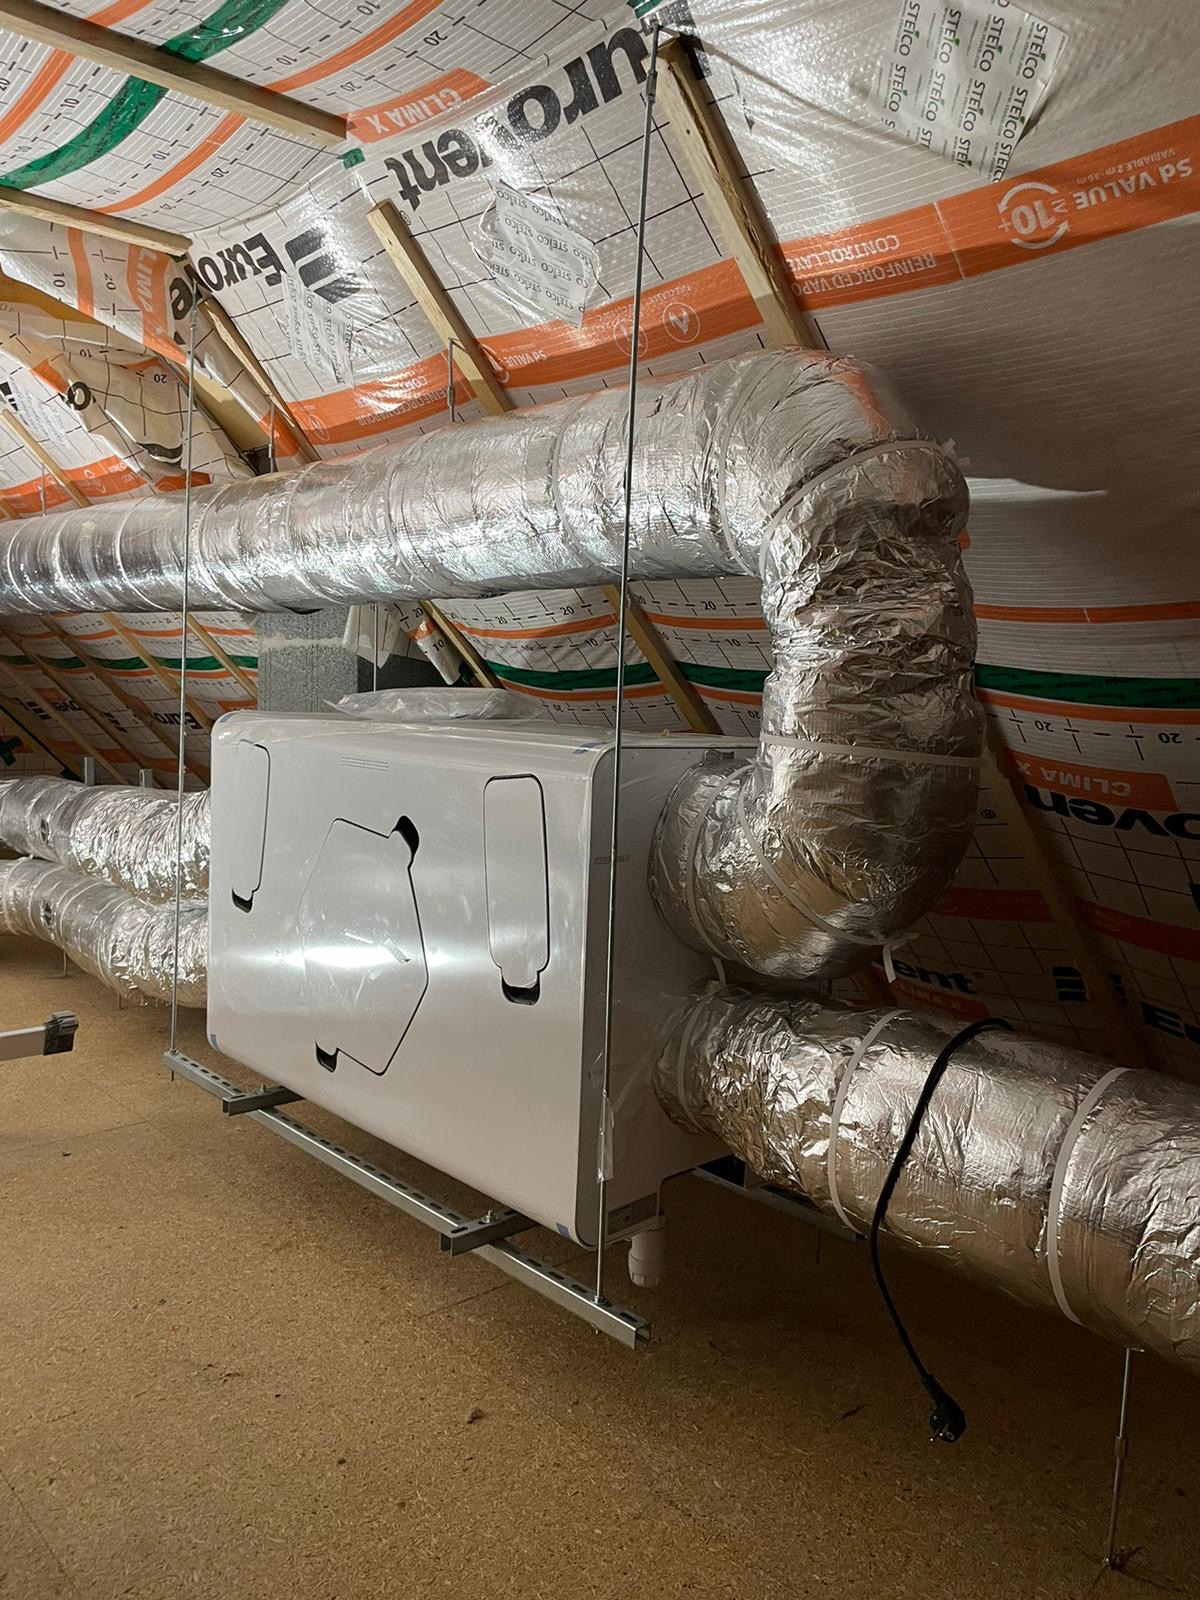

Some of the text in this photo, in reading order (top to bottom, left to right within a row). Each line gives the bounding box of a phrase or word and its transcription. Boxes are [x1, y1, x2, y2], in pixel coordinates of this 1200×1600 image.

[424, 30, 449, 47] 20
[899, 1, 921, 57] STEICO
[939, 8, 962, 64] STEICO
[979, 15, 1006, 73] STEICO
[1022, 23, 1049, 80] STEICO
[276, 54, 298, 66] 10
[339, 81, 363, 93] 20
[888, 63, 909, 113] STEICO
[925, 71, 947, 122] STEICO
[60, 98, 80, 109] 10
[384, 87, 462, 129] CLIMA
[962, 80, 986, 132] STEICO
[1003, 87, 1029, 139] STEICO
[152, 150, 170, 161] 10
[210, 167, 230, 178] 20
[1158, 158, 1193, 184] Sd
[496, 190, 528, 209] STEICO
[1072, 171, 1158, 210] VALUE
[504, 217, 534, 238] STEICO
[536, 233, 569, 253] STEICO
[820, 234, 901, 263] CONTROL
[509, 245, 537, 267] STEICO
[52, 270, 66, 289] 10
[541, 262, 572, 281] STEICO
[831, 252, 937, 289] REINFORCED
[103, 272, 117, 292] 20
[545, 289, 574, 310] STEICO
[153, 373, 168, 384] 20
[412, 607, 425, 618] 20
[559, 605, 575, 616] 20
[701, 600, 718, 611] 20
[494, 616, 508, 625] 20
[432, 639, 445, 652] 10
[585, 638, 599, 647] 10
[726, 638, 741, 647] 10
[1034, 720, 1055, 732] 20
[1158, 732, 1184, 744] 20
[1039, 766, 1132, 797] CLIMA
